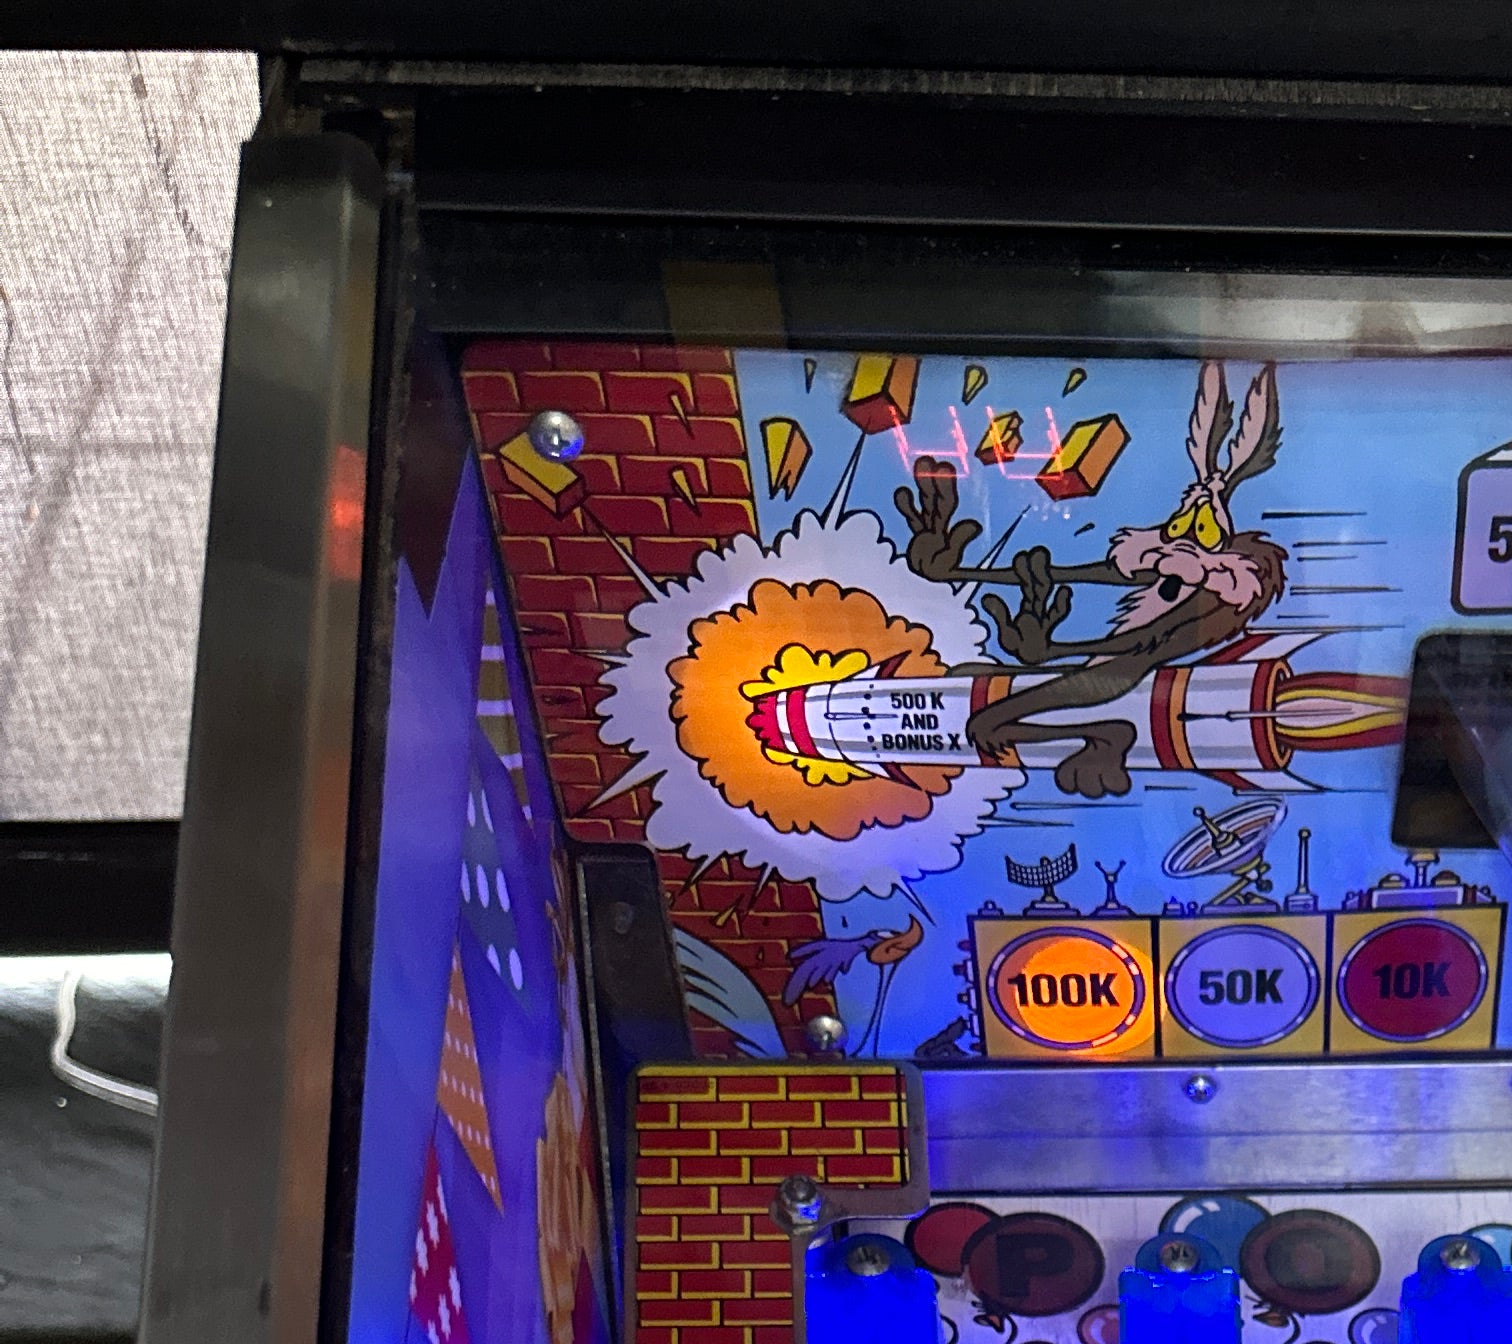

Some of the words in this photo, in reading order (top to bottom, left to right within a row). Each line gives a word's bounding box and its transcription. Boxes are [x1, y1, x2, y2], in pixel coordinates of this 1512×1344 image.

[890, 692, 926, 710] 500
[930, 692, 945, 710] K
[901, 713, 939, 730] AND
[882, 733, 944, 750] BONUS
[948, 733, 961, 751] X
[1008, 972, 1120, 1007] 100K
[1199, 969, 1284, 1005] 50K
[1373, 961, 1452, 999] 10K
[996, 1232, 1076, 1298] P
